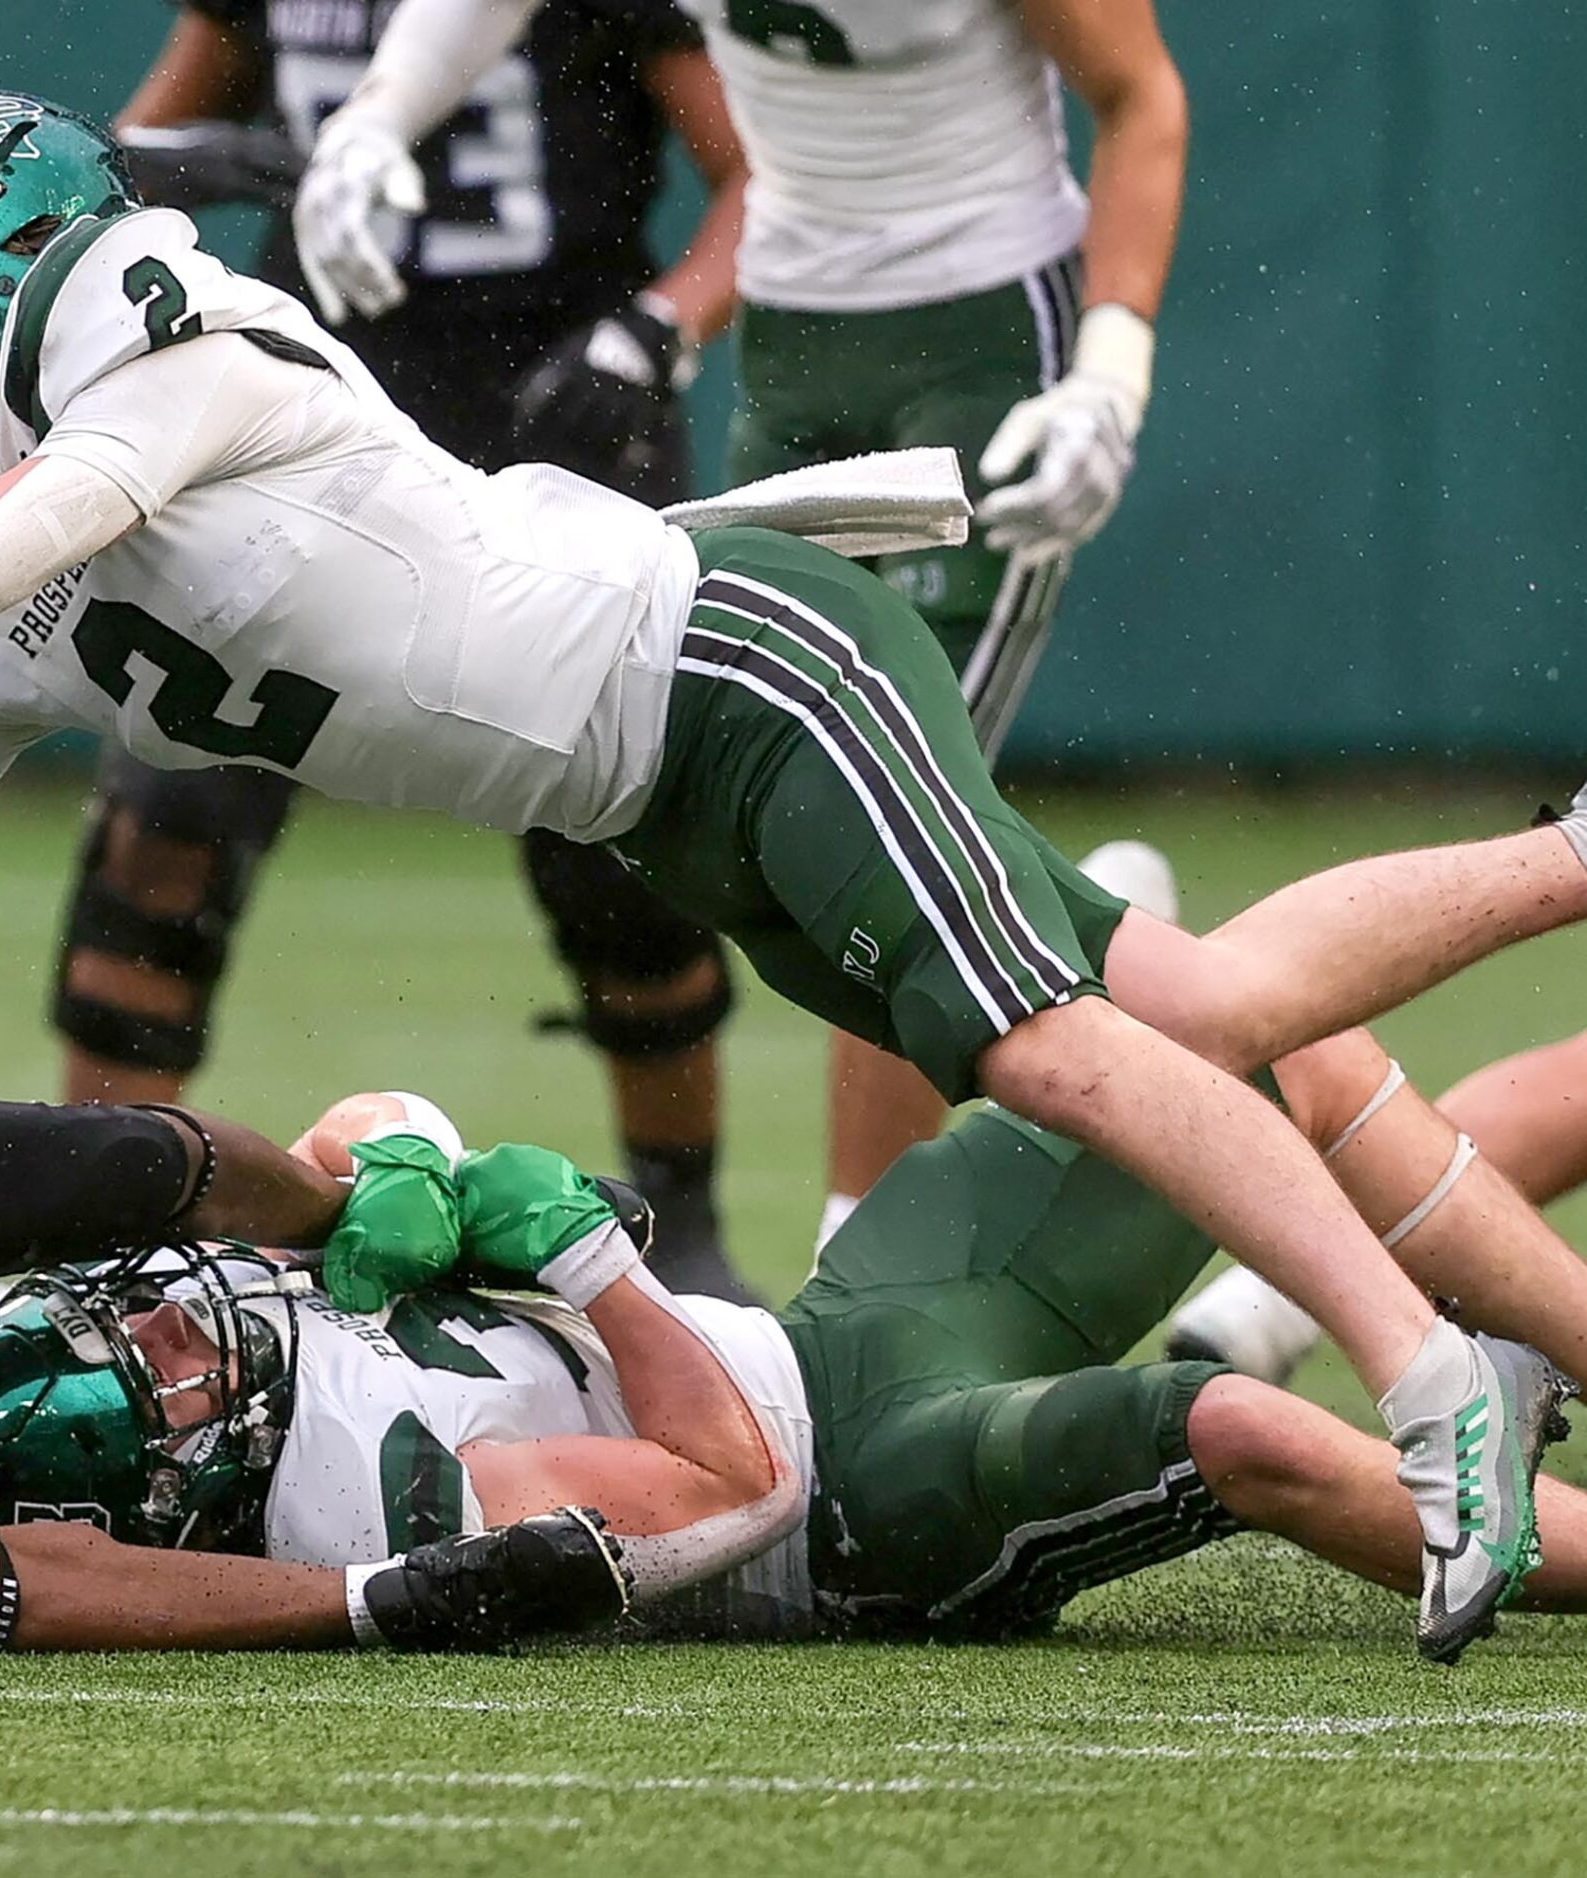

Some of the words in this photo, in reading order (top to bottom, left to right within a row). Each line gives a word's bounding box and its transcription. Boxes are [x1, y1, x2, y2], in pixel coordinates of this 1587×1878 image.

[122, 255, 203, 352] 2
[8, 555, 91, 659] PROSPE
[71, 596, 341, 770] 2
[842, 926, 880, 982] YJ
[192, 1420, 226, 1464] Ridde
